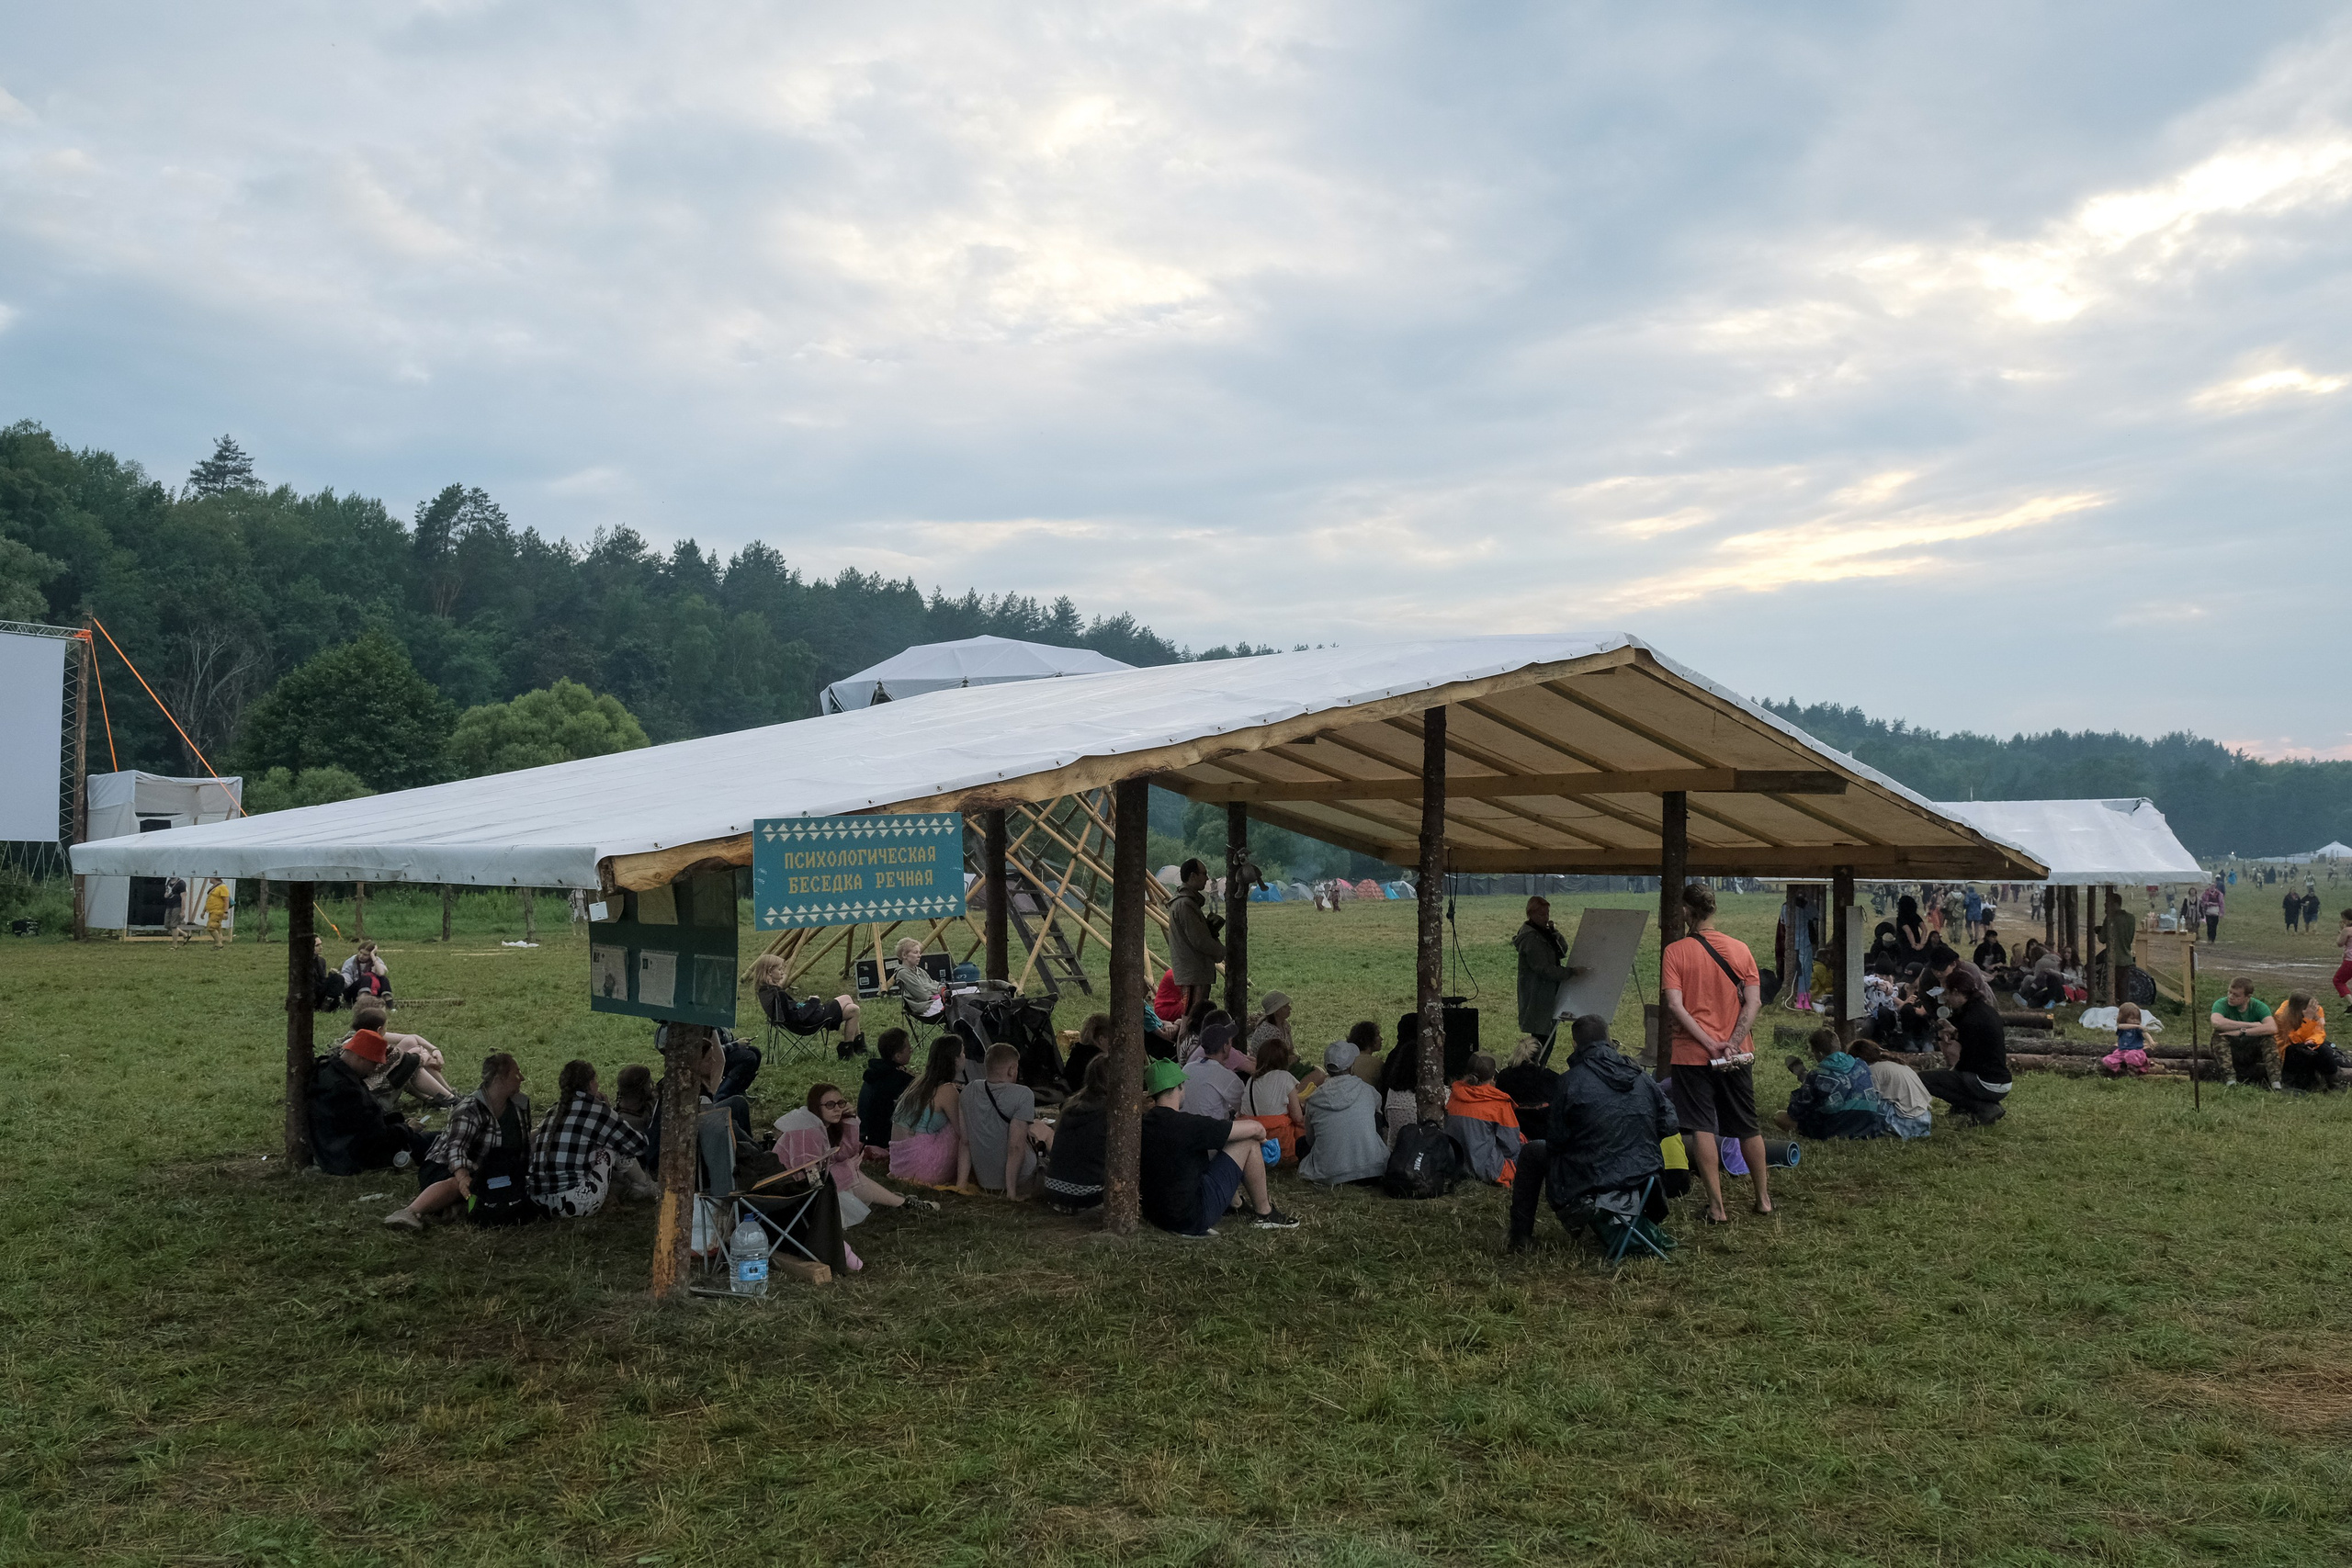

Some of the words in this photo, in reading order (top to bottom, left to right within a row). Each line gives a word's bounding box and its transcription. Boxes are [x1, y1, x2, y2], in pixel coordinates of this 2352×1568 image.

[785, 845, 936, 870] ПСИХОЛОГИЧЕСКАЯ
[788, 874, 863, 894] БЕСЕДКА
[876, 869, 933, 888] РЕЧНАЯ
